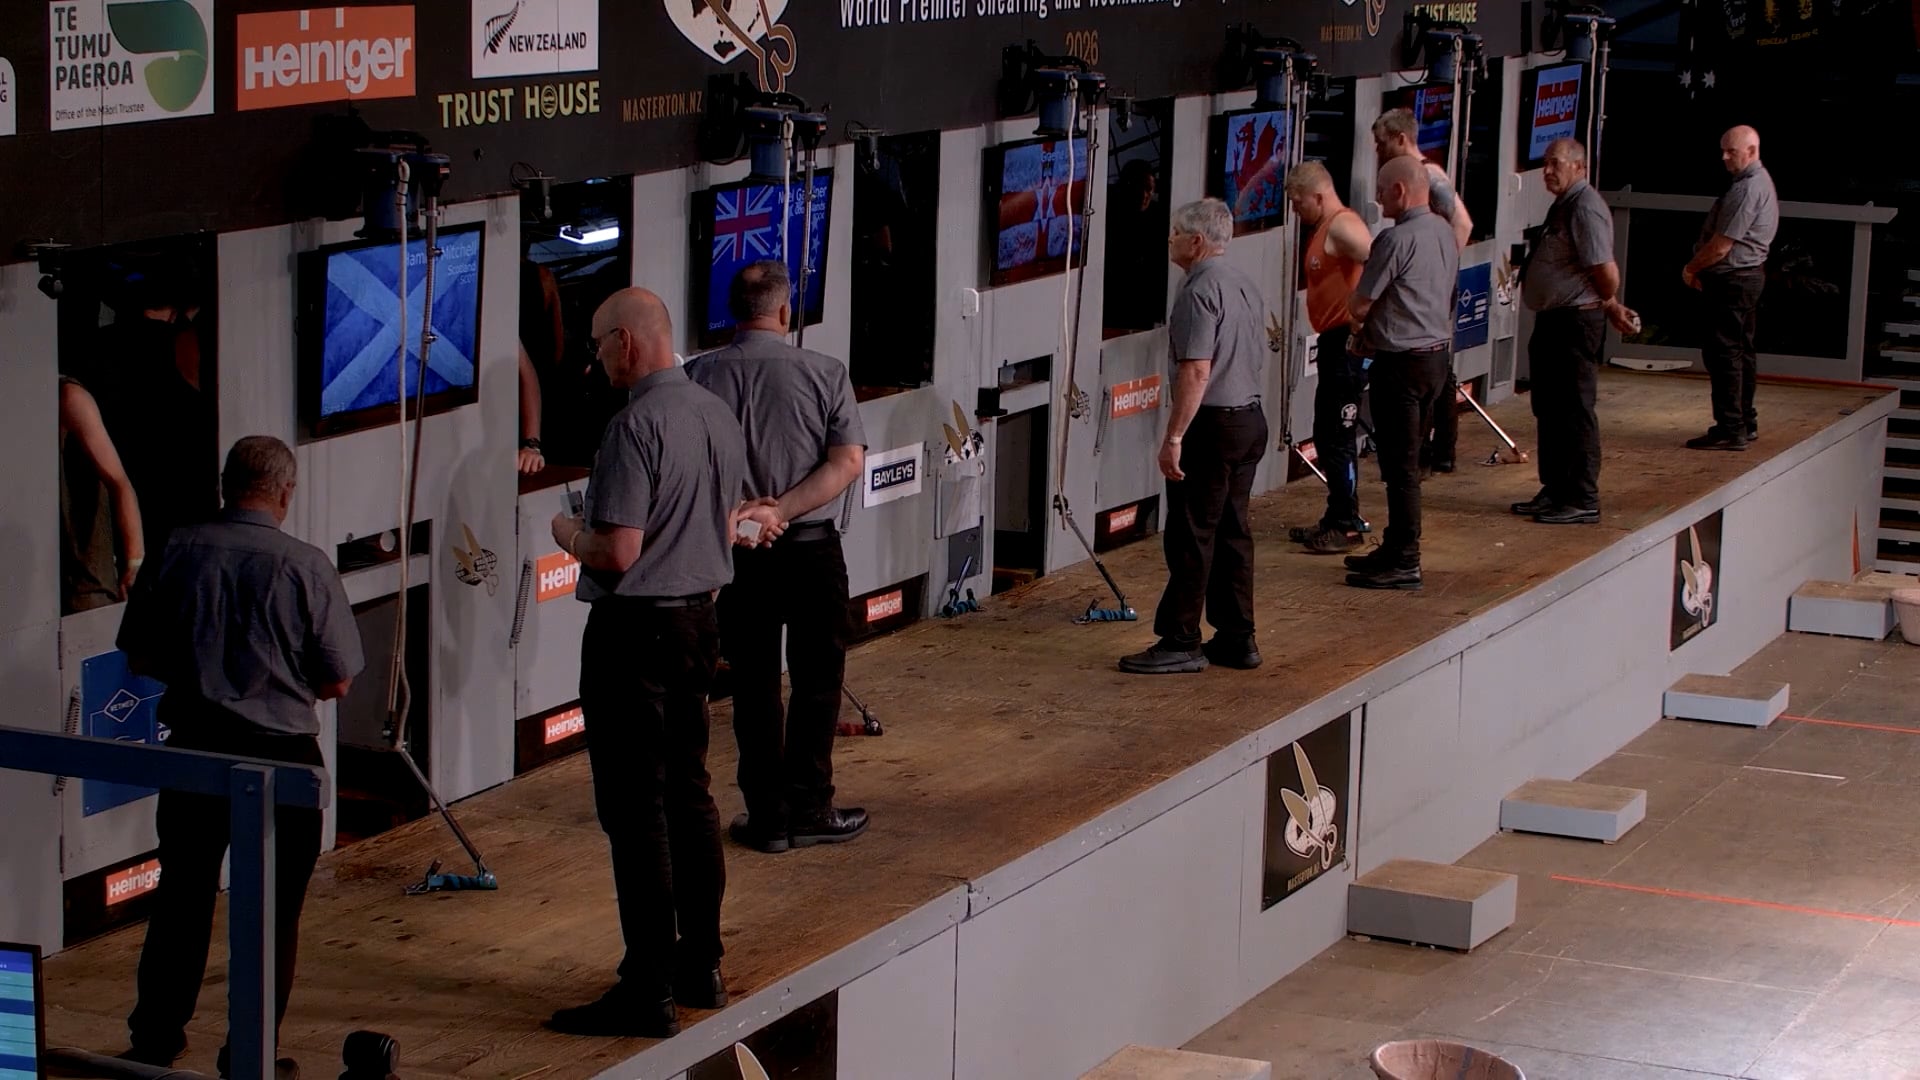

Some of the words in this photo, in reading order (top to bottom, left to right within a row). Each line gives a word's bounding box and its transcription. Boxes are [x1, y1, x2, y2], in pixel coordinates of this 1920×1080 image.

[55, 6, 77, 31] TE
[55, 33, 111, 61] TUMU
[244, 10, 411, 93] Heiniger
[508, 34, 535, 53] NEW
[536, 31, 587, 52] ZEALAND
[1065, 30, 1099, 66] 2026
[56, 60, 134, 90] PAEROA
[438, 88, 514, 129] TRUST
[524, 80, 601, 119] HOUSE
[623, 91, 704, 123] MASTERTON.NZ
[1114, 378, 1160, 412] Heiniger
[873, 463, 914, 487] BAYLEYS
[110, 863, 161, 898] Heinige
